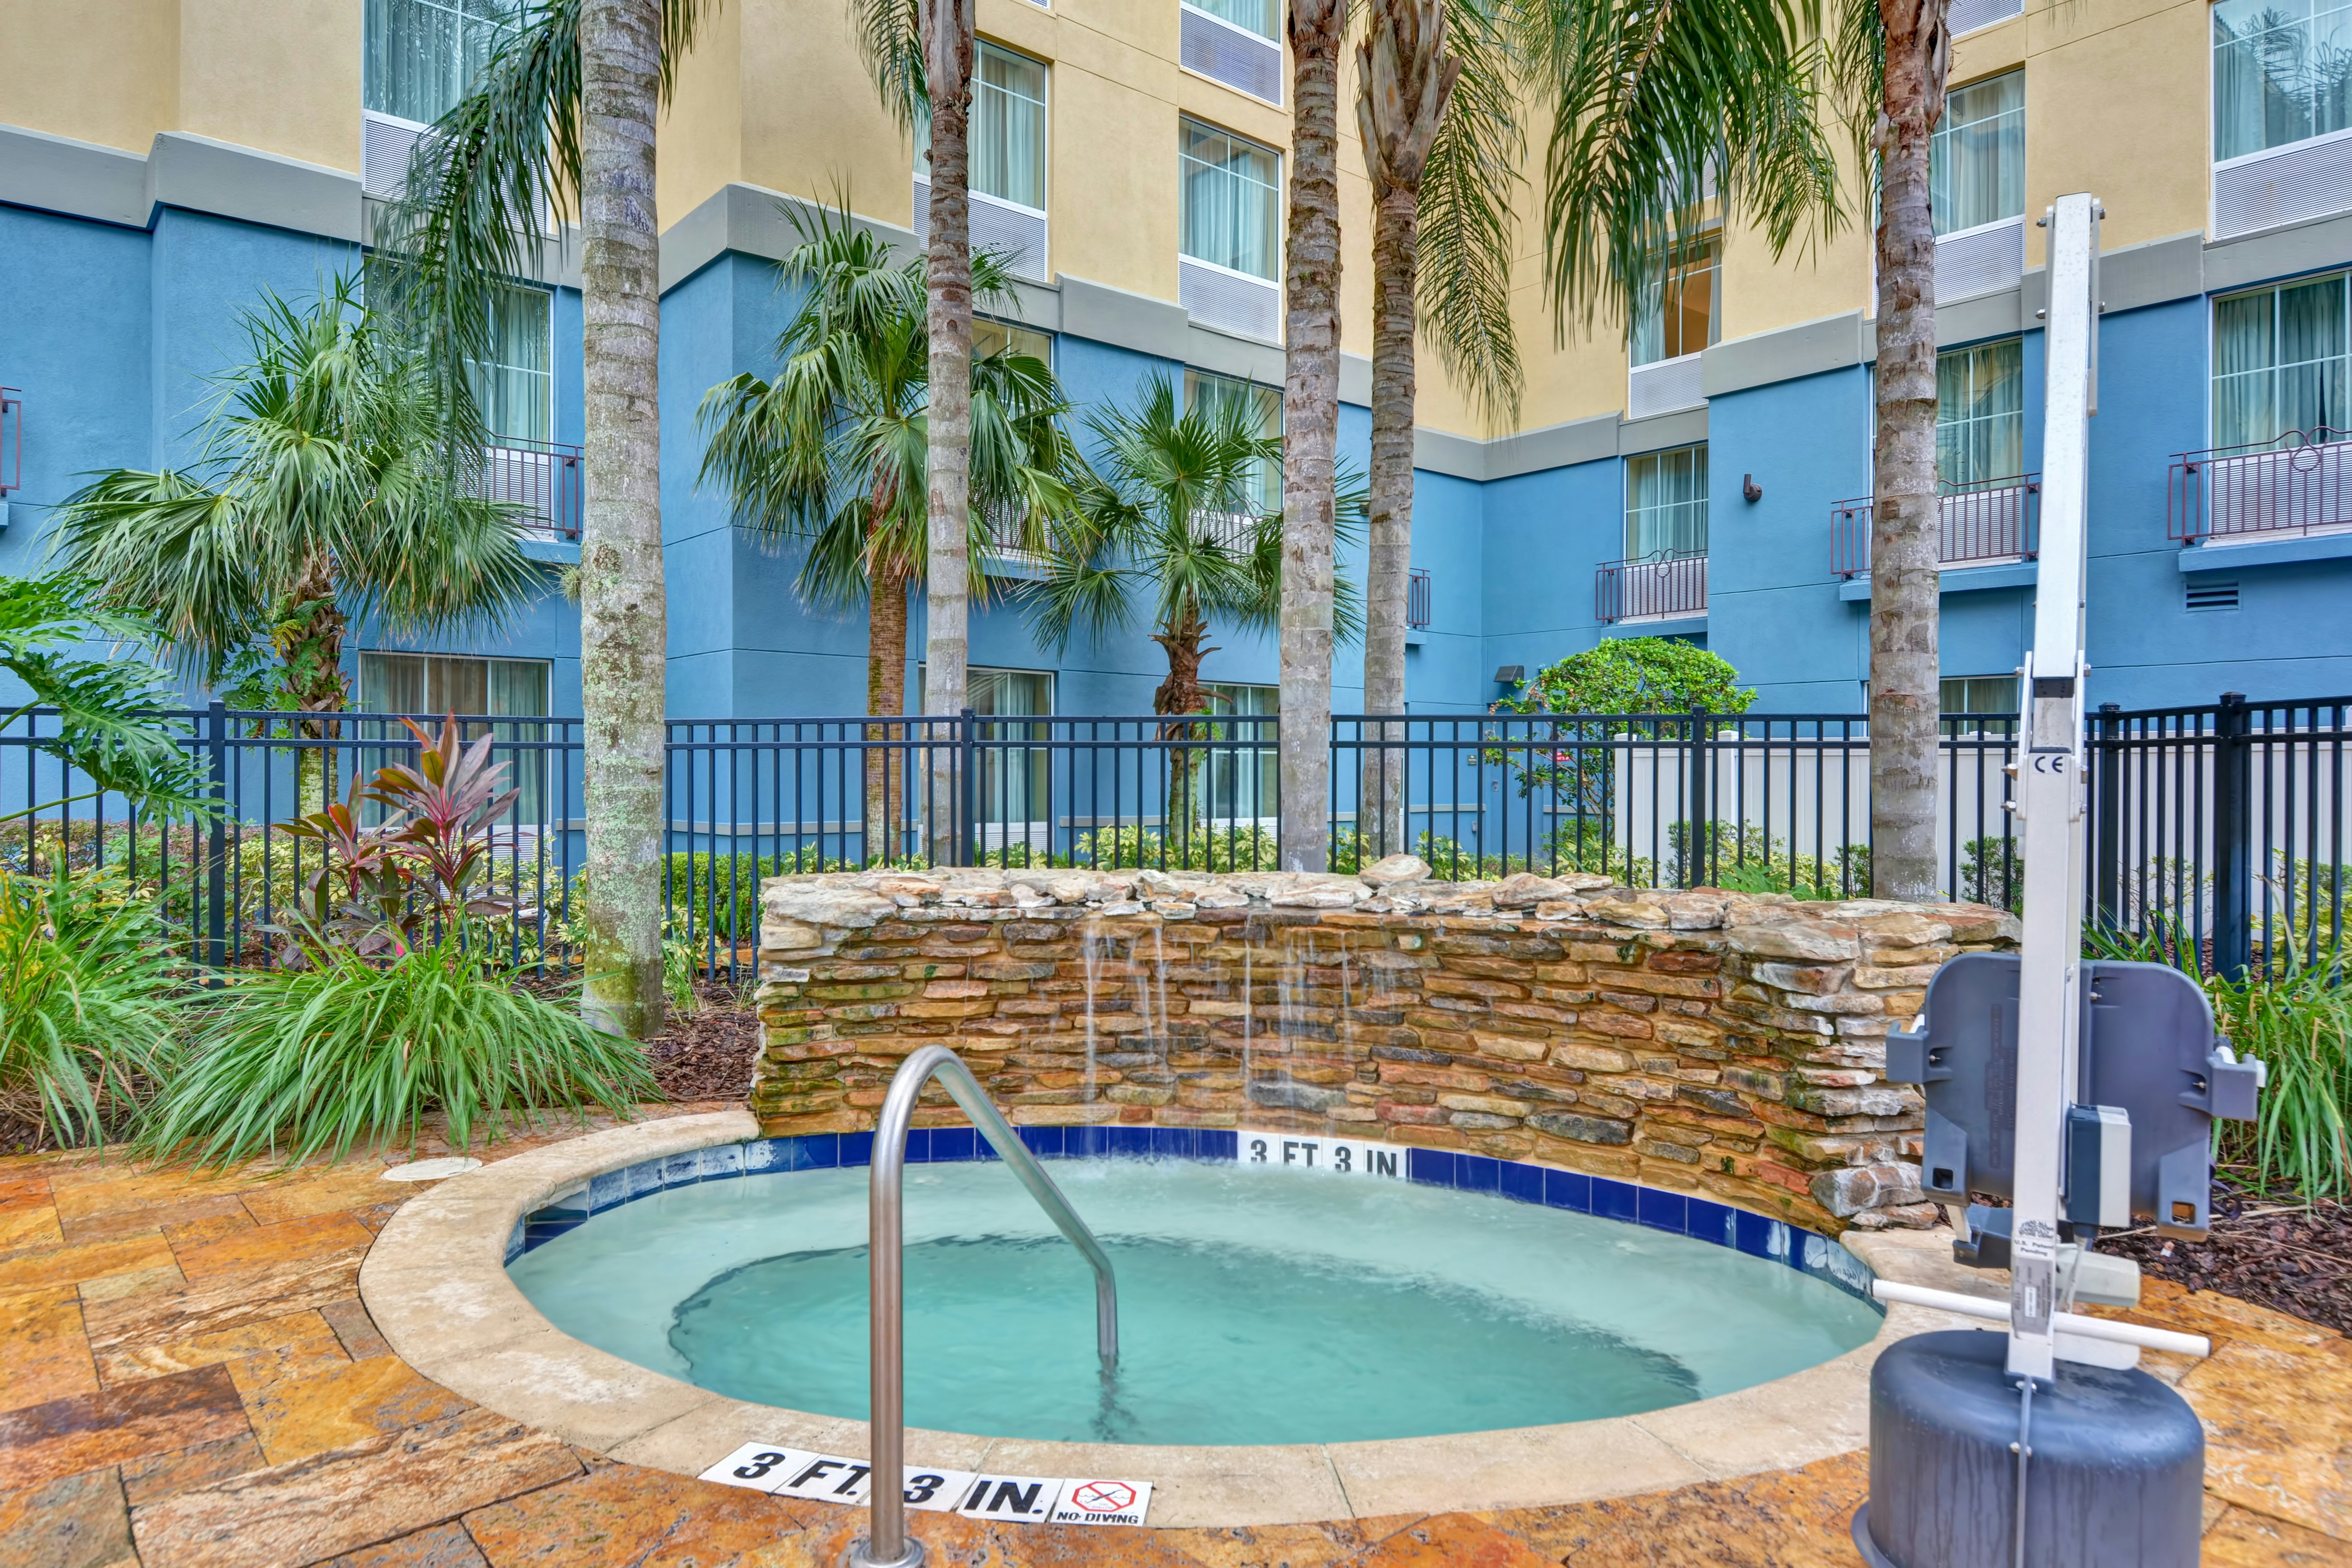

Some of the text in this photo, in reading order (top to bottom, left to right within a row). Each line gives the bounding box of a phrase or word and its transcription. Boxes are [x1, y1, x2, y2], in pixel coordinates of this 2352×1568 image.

[2035, 756, 2063, 773] CE
[1251, 1140, 1396, 1176] 3 FT 3 IN
[2021, 1247, 2048, 1257] Pending
[733, 1452, 1043, 1514] 3 FT. 3 IN.
[1056, 1512, 1139, 1525] NO DIVING
